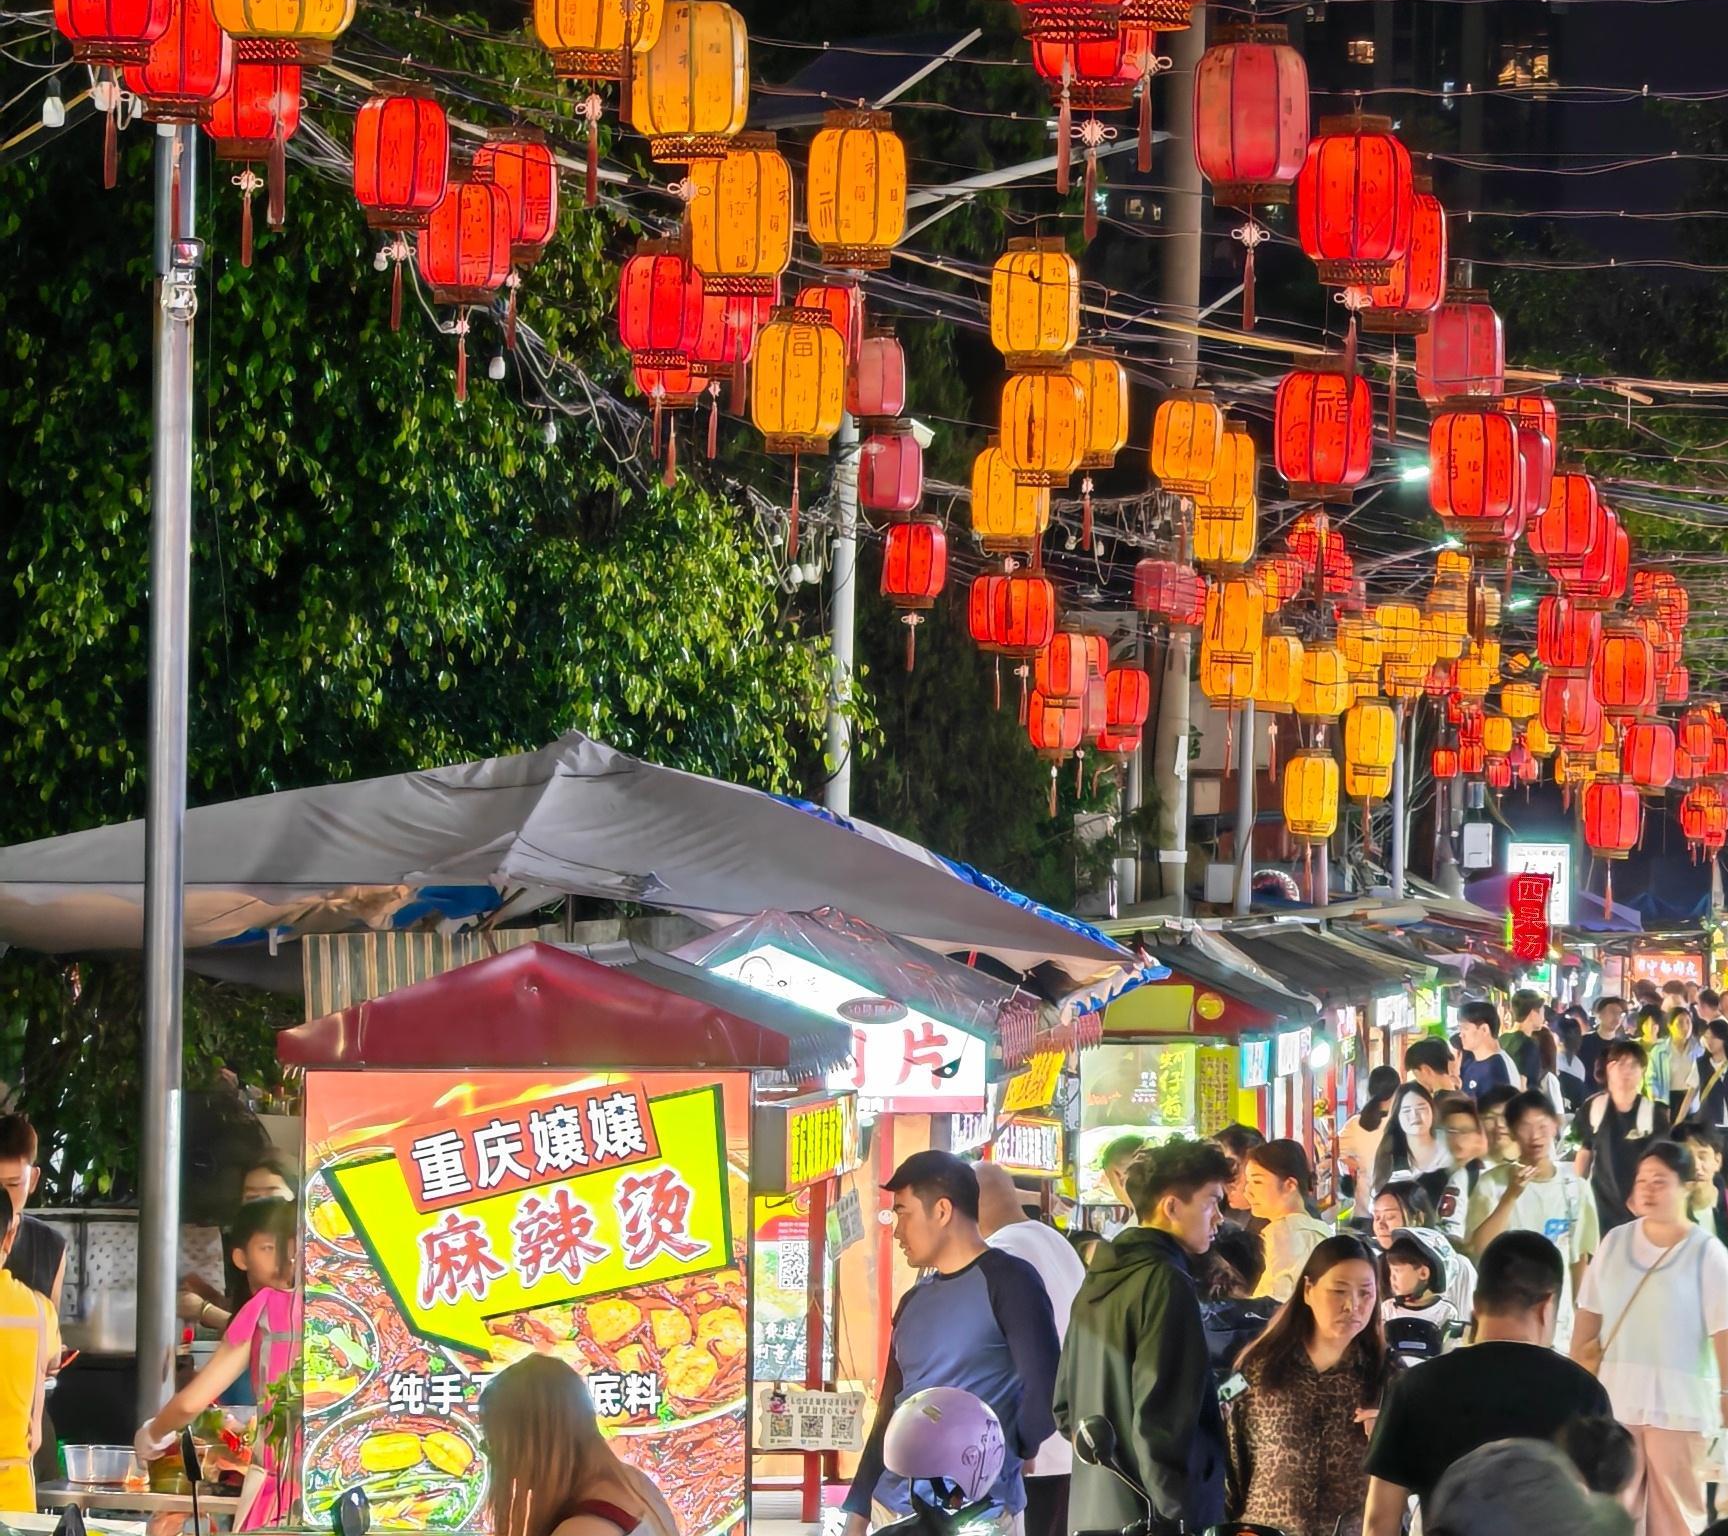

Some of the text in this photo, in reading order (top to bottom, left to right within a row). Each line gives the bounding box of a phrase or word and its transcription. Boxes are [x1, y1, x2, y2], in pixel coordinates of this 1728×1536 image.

[1515, 880, 1548, 957] 四果汤
[1159, 1050, 1187, 1123] 蚵仔煎
[418, 1168, 704, 1307] 麻辣烫
